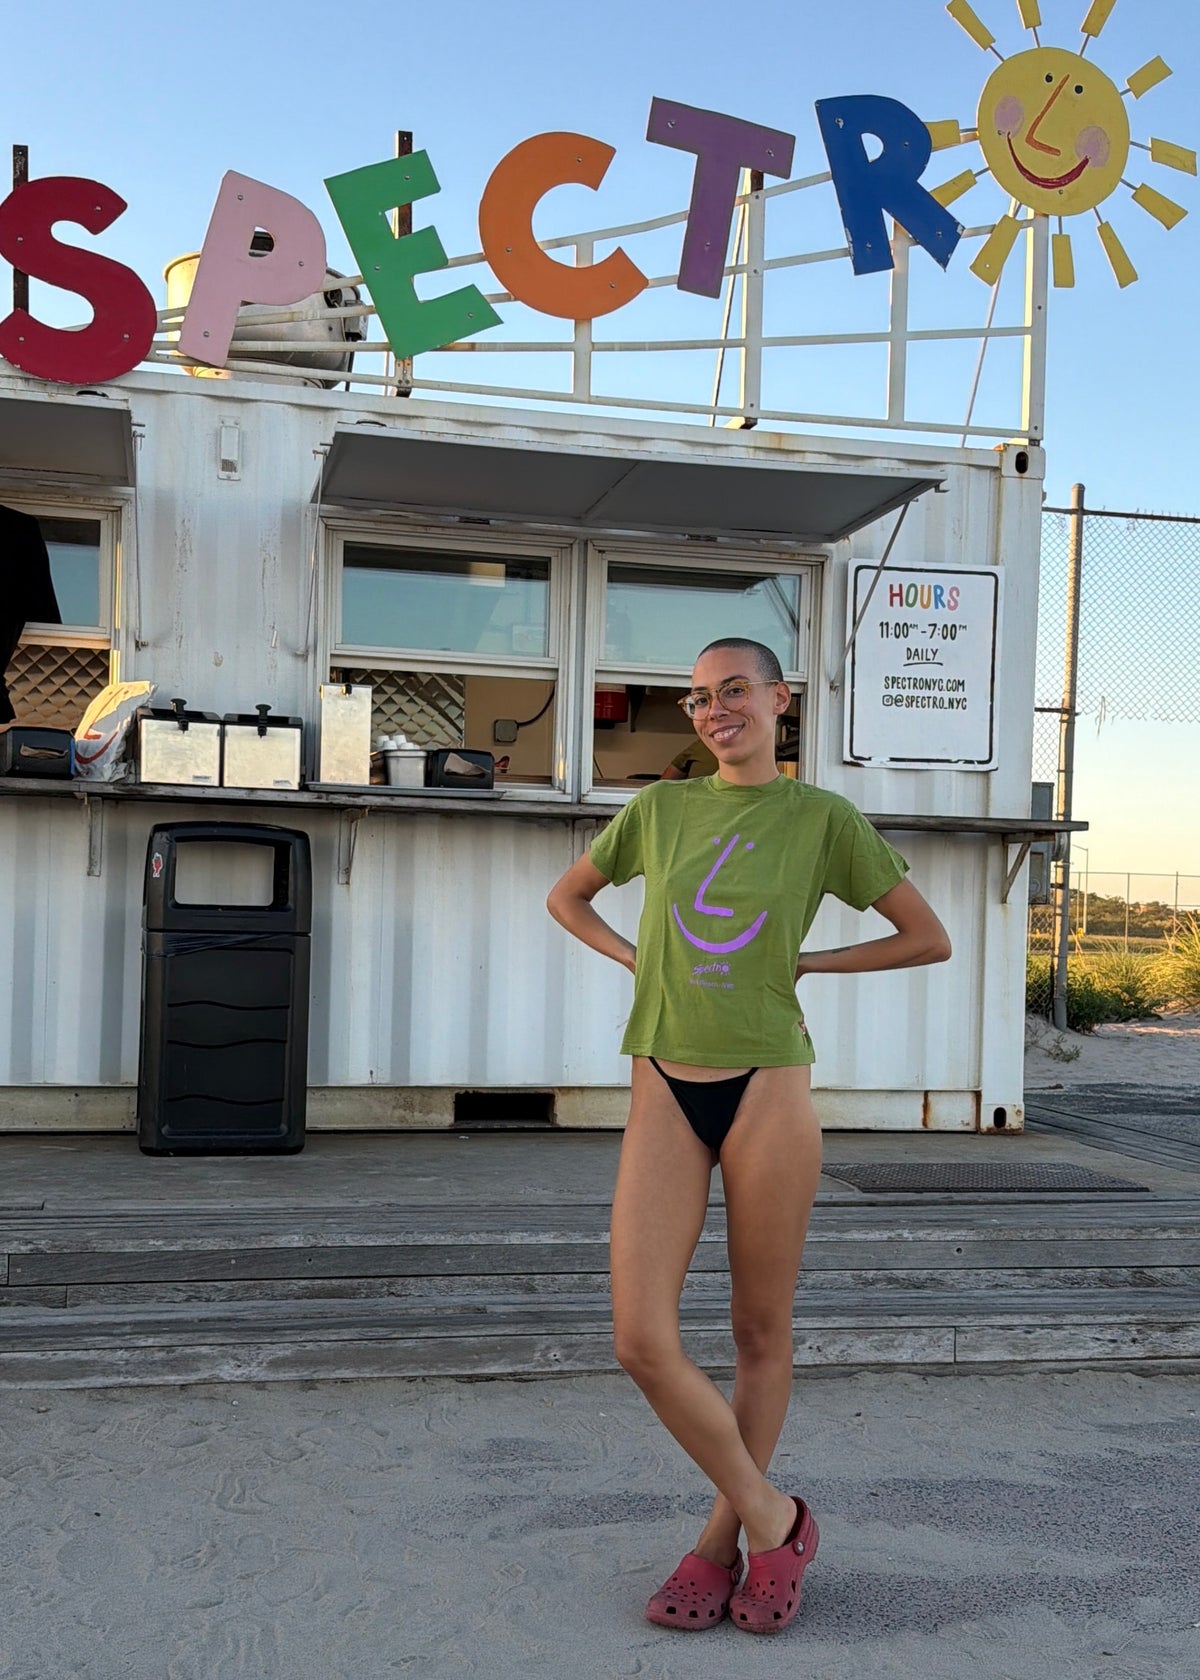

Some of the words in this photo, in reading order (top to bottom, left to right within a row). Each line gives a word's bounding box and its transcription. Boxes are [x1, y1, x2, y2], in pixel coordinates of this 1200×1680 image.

[889, 583, 960, 611] HOURS
[906, 647, 939, 661] DAILY
[884, 676, 965, 692] SPECTRONYC.COM
